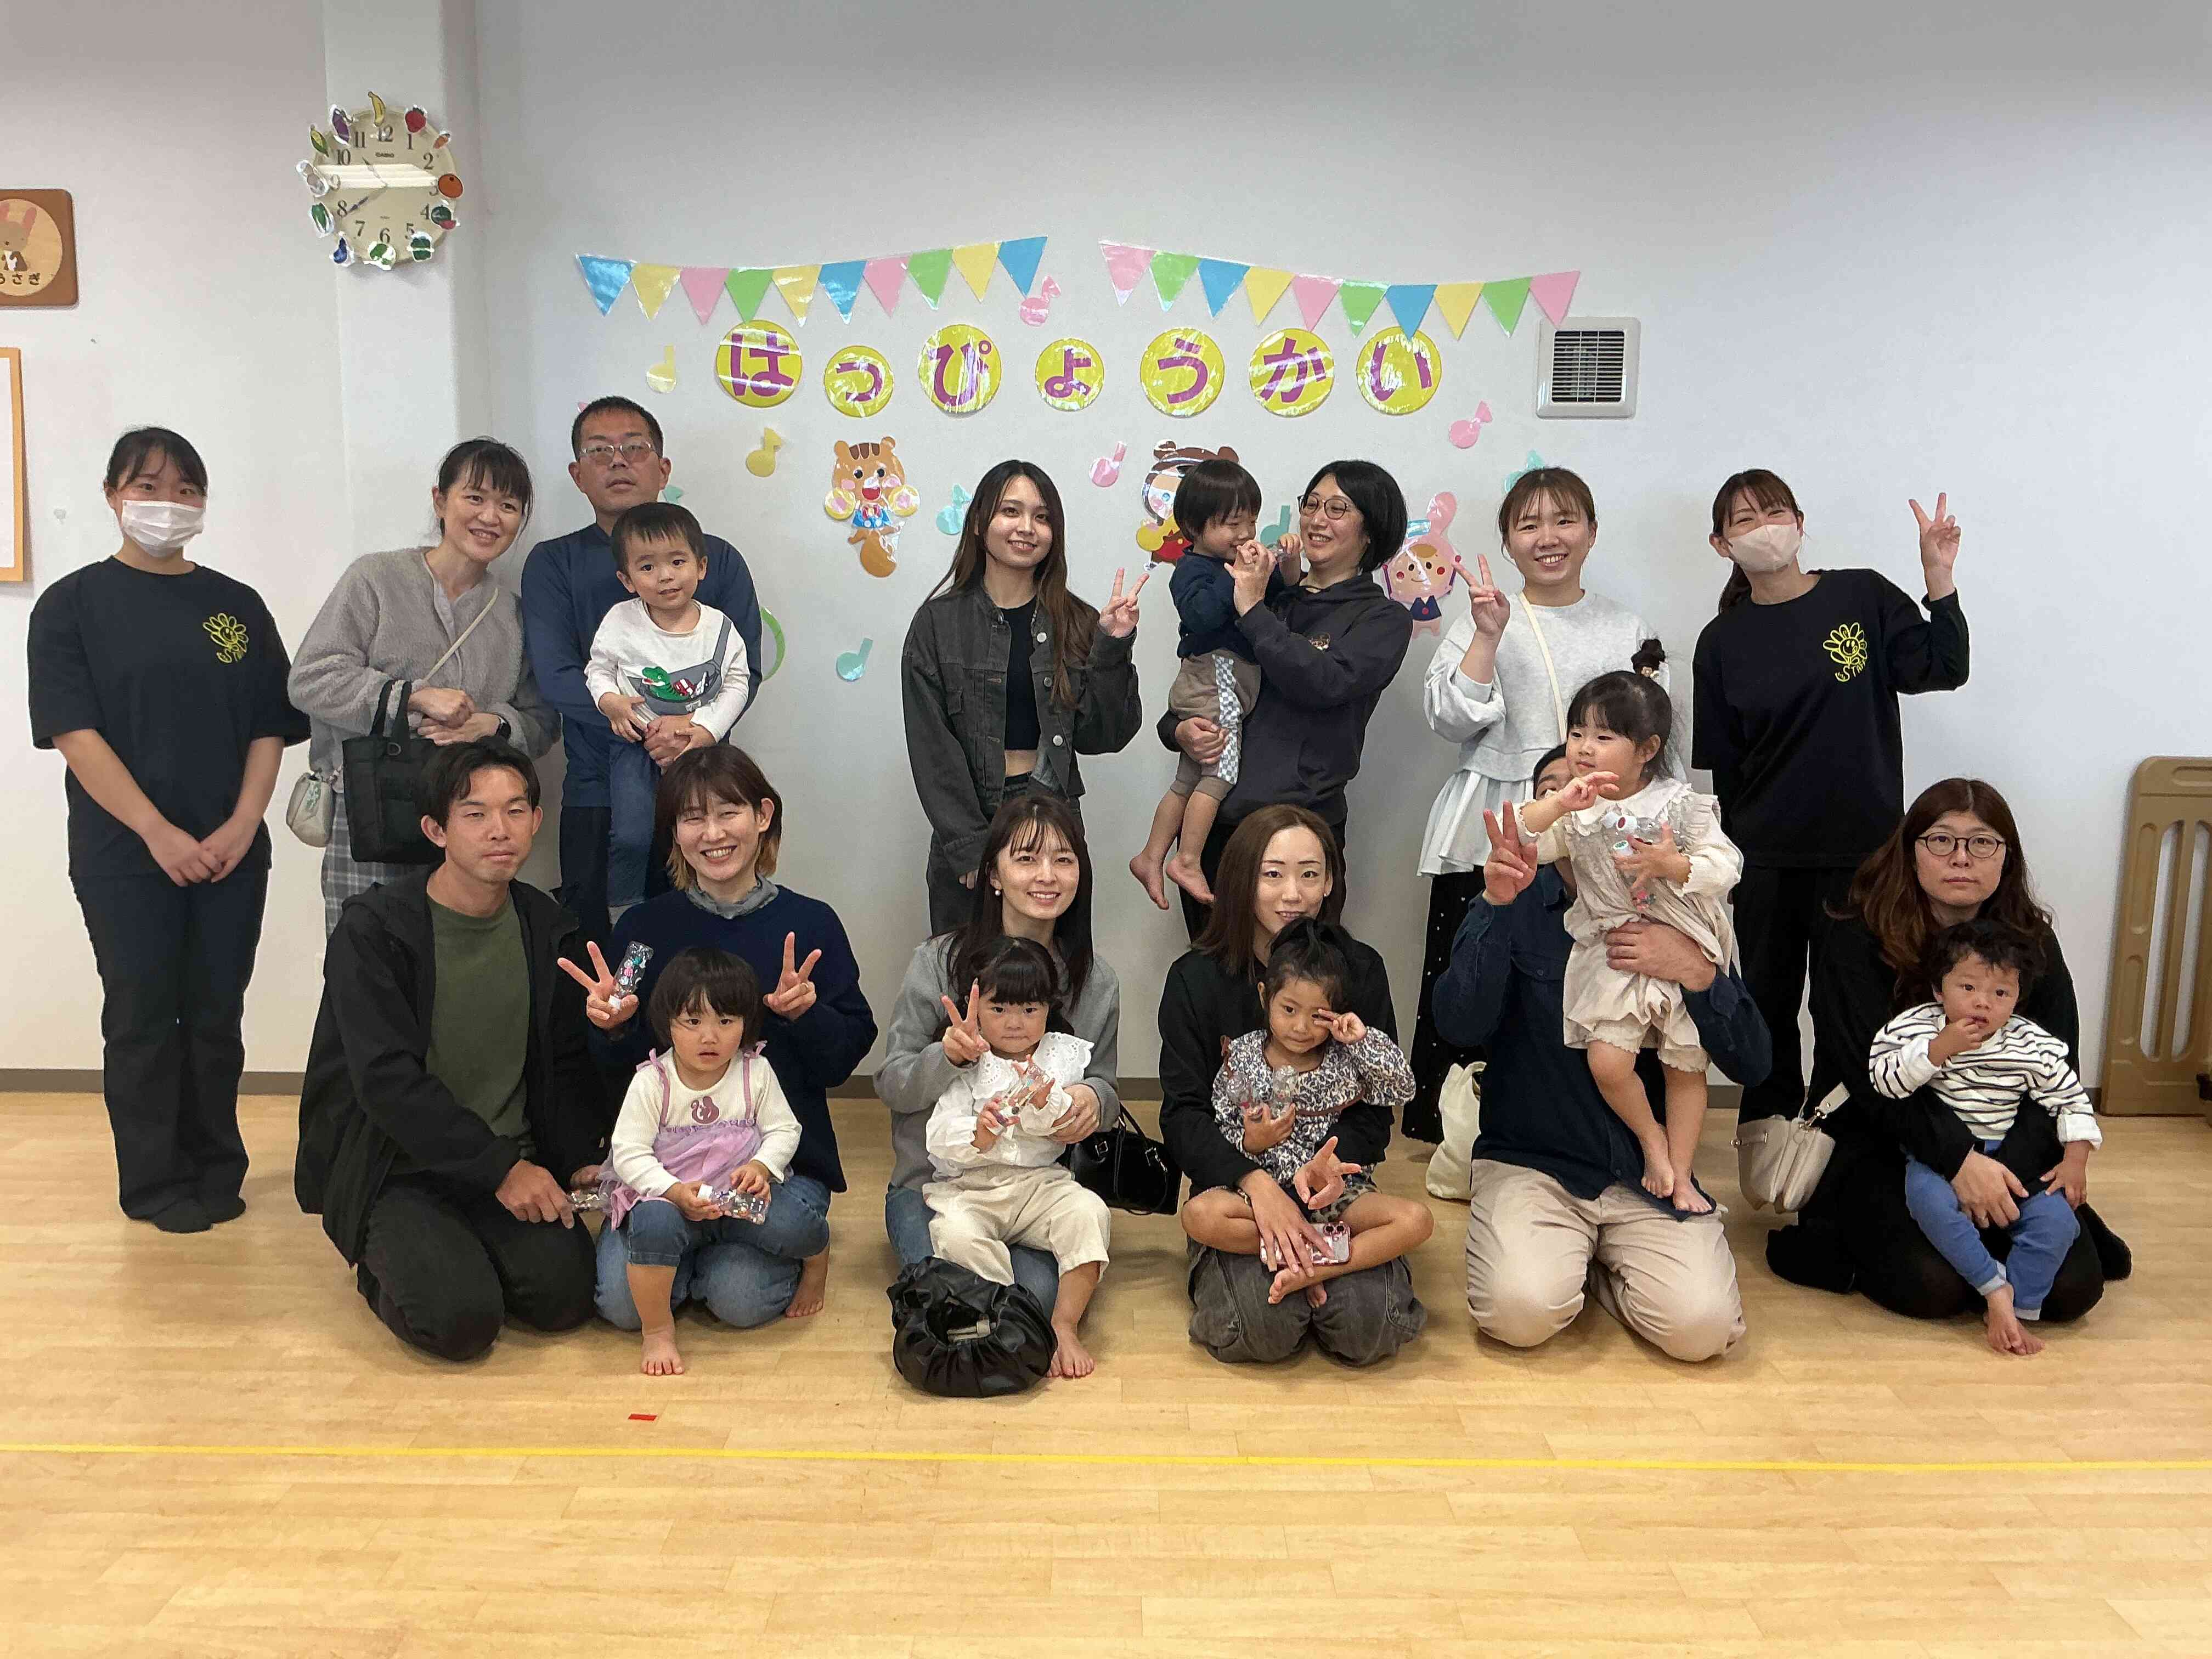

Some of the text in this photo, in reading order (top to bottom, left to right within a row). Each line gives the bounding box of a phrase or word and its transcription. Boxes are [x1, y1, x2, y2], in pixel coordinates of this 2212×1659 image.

[354, 131, 366, 149] 11
[377, 125, 393, 142] 12
[408, 133, 414, 150] 1
[337, 149, 351, 166] 10
[423, 153, 434, 170] 2
[337, 200, 348, 217] 8
[420, 203, 430, 220] 4
[355, 220, 365, 237] 7
[379, 228, 391, 244] 6
[405, 223, 415, 239] 5
[730, 330, 1432, 408] はっぴょうかい
